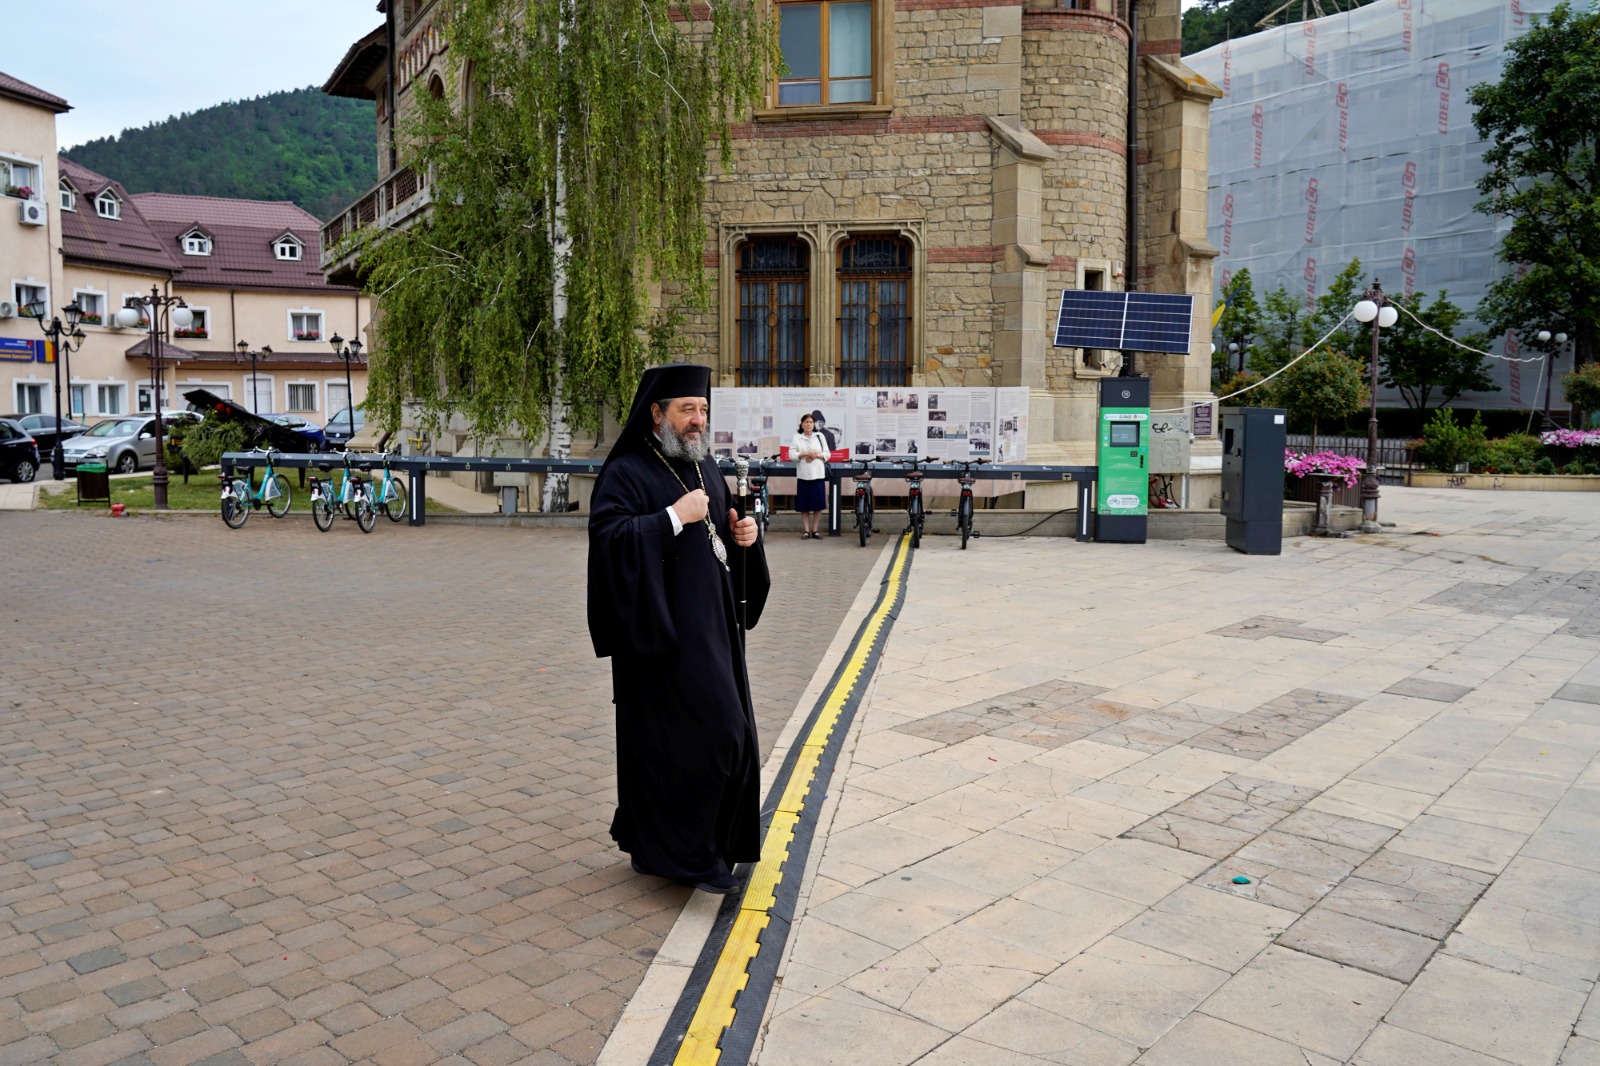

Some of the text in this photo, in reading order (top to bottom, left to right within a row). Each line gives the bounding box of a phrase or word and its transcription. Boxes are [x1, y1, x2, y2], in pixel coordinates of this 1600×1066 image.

[1403, 13, 1411, 52] LIDER
[1305, 40, 1315, 76] LIDER
[1339, 111, 1348, 152] LIDER
[1439, 92, 1450, 135] LIDER
[1254, 130, 1263, 168] LIDER
[1305, 205, 1317, 244] LIDER
[1401, 190, 1414, 232] LIDER
[1222, 219, 1232, 256] LIDER
[1510, 361, 1521, 403] LIDER
